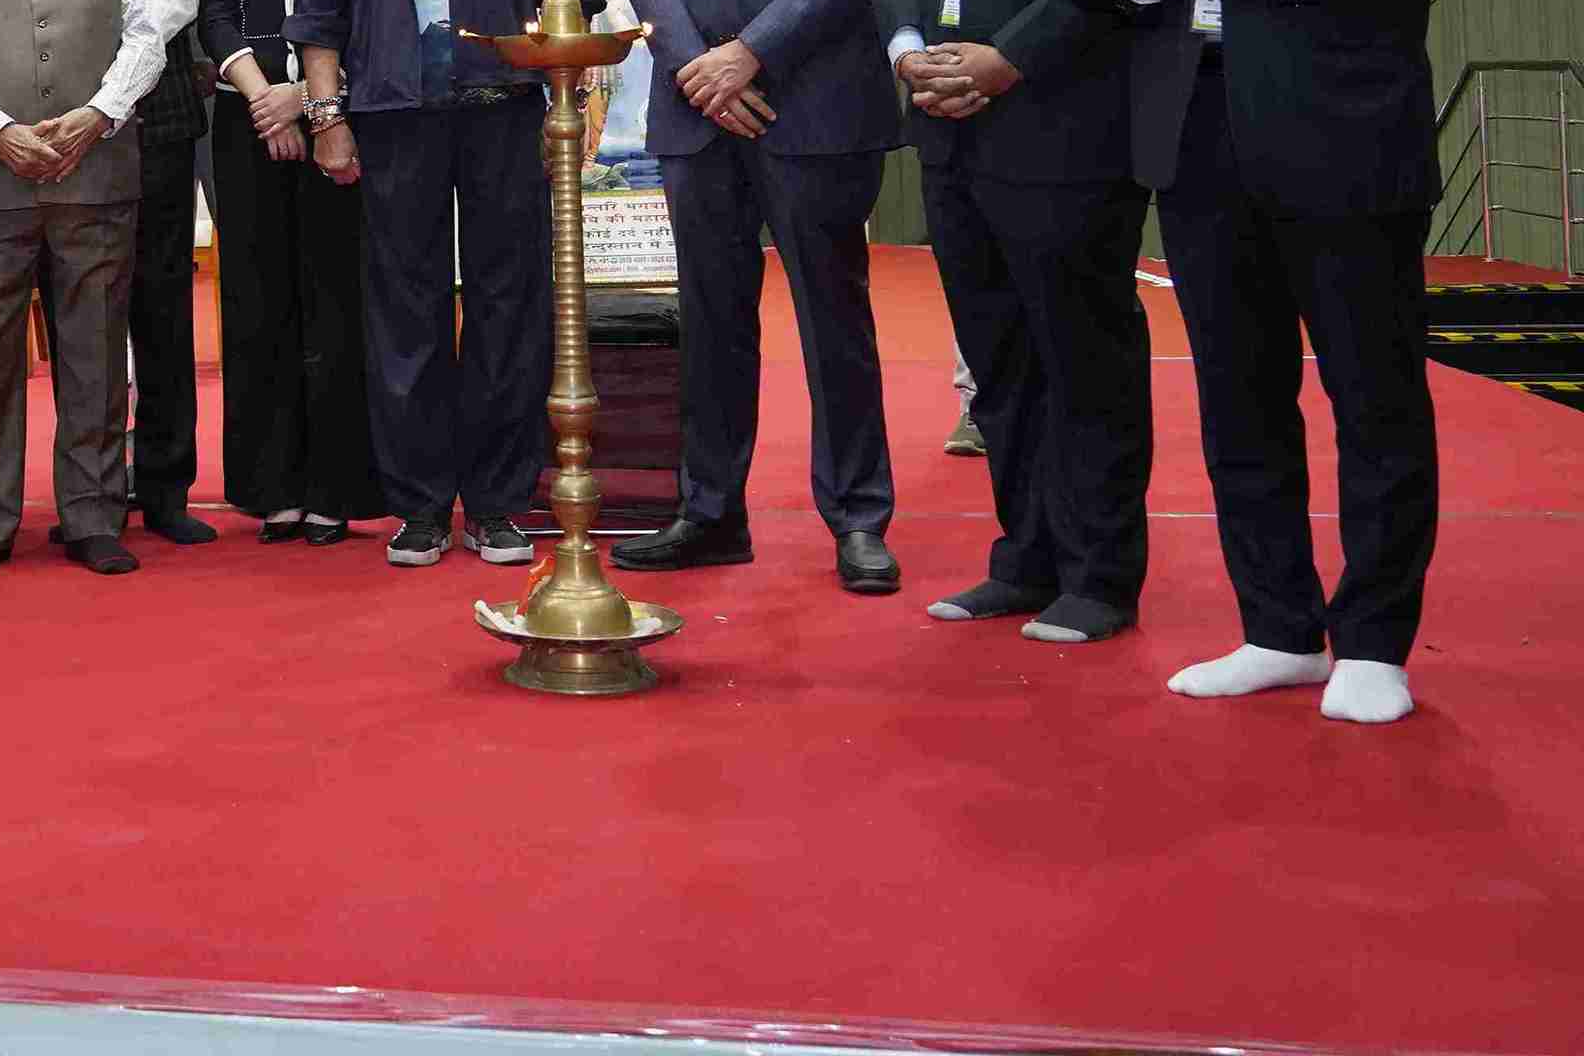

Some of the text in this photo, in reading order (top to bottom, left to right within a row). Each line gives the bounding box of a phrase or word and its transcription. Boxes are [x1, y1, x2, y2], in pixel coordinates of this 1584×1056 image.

[583, 200, 665, 212] न्तरि भगवा
[605, 212, 624, 224] की
[584, 241, 642, 253] न्दुस्तान
